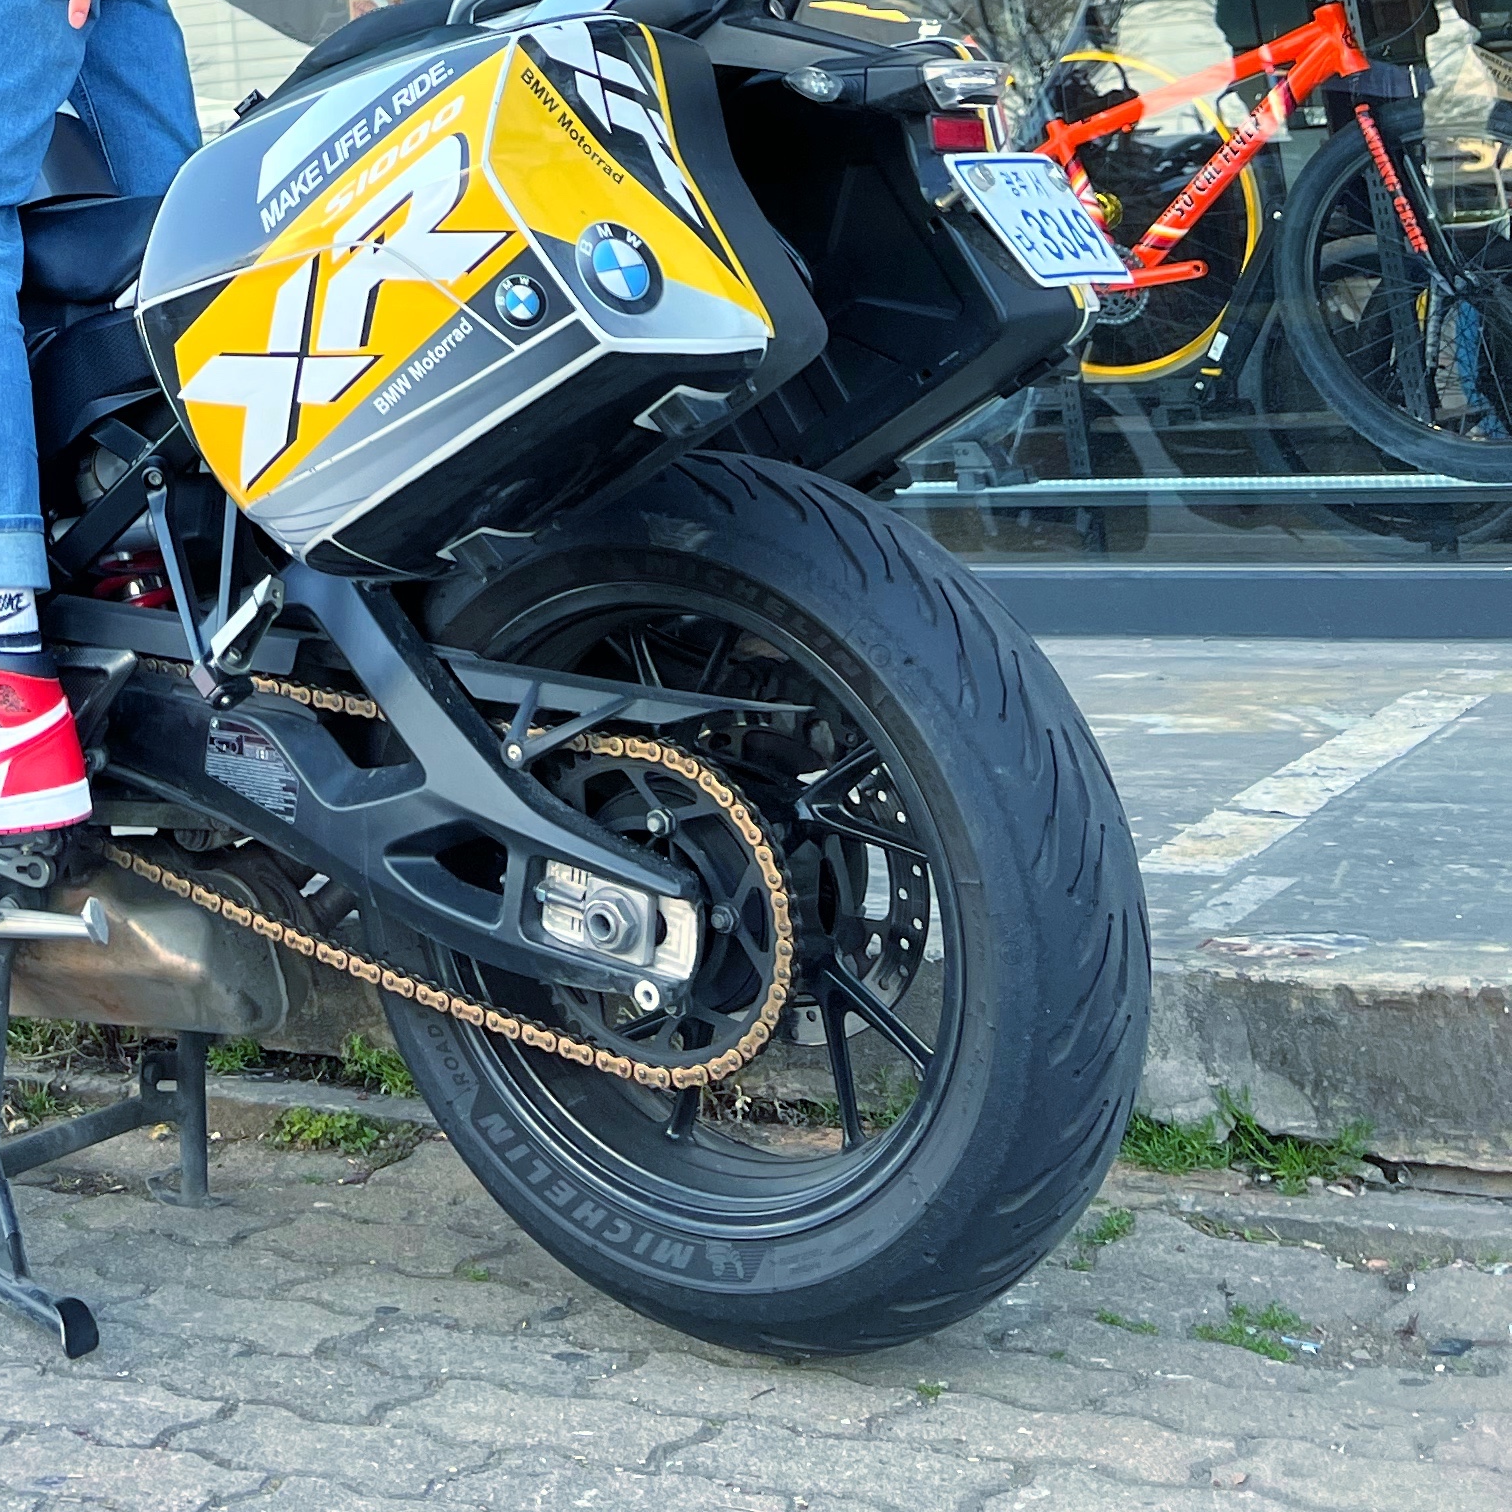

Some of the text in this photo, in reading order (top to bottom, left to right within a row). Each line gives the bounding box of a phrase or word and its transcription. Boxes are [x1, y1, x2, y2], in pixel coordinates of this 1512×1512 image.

[259, 60, 455, 234] MAKE LIFE A RIDE.
[321, 95, 465, 227] S1000
[520, 68, 625, 185] BMW Motorrad
[580, 223, 642, 256] BMW
[1021, 208, 1108, 261] 3349
[179, 134, 514, 492] XR
[495, 276, 531, 306] BMW
[373, 316, 474, 416] BMW Motorrad
[427, 1023, 470, 1087] ROAD
[477, 1112, 698, 1270] MICHELIN
